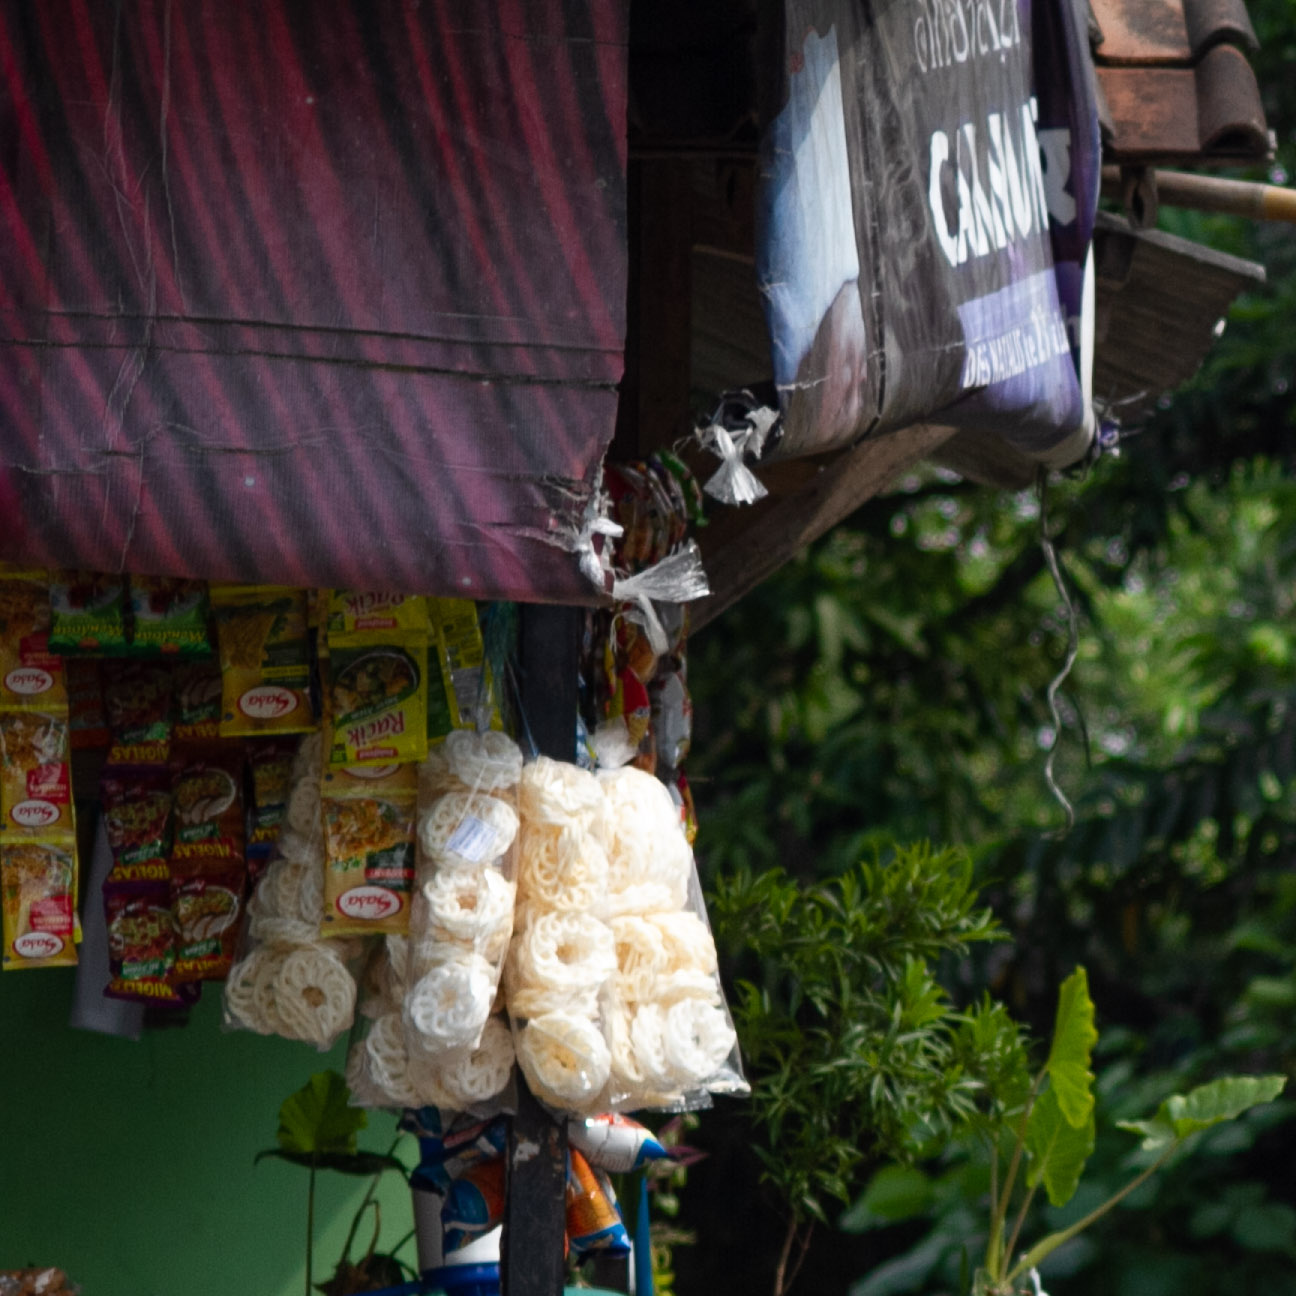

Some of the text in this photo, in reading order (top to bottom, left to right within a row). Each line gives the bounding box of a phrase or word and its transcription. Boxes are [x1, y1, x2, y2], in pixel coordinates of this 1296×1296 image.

[246, 692, 291, 715] Sasa
[348, 711, 405, 748] Racik
[346, 894, 393, 916] Sasa
